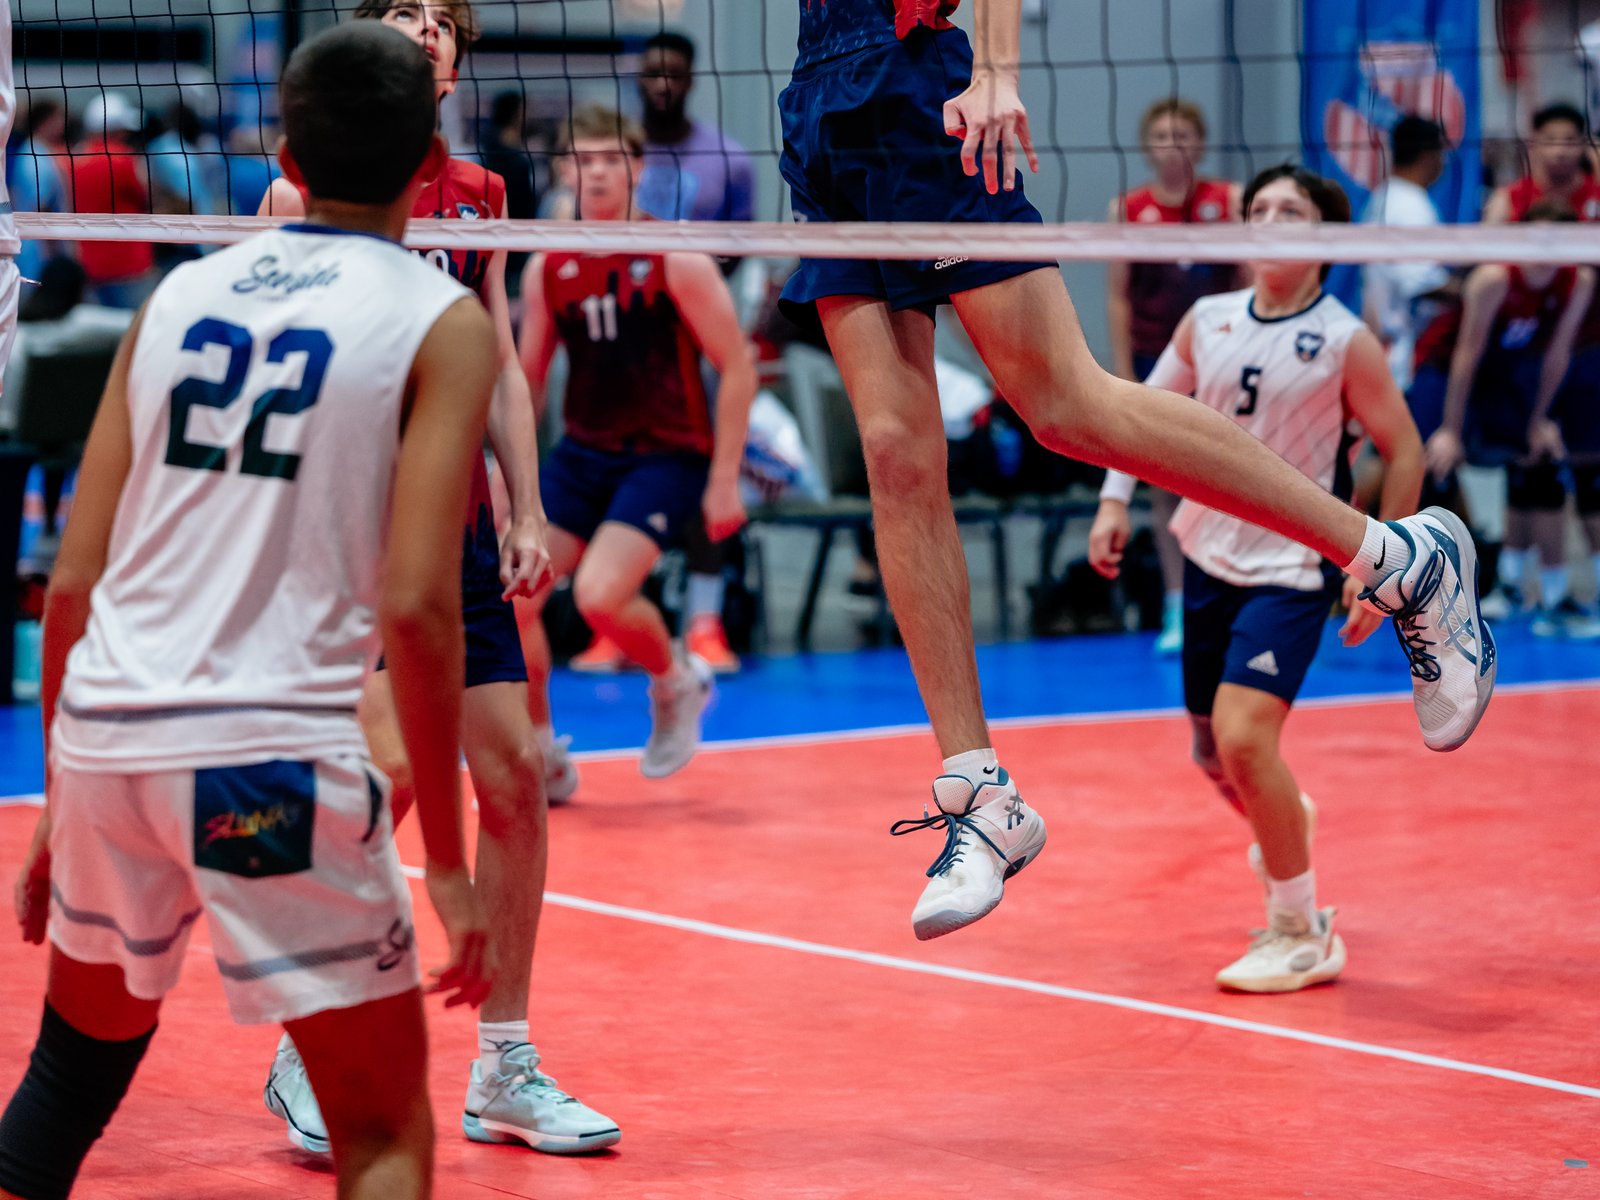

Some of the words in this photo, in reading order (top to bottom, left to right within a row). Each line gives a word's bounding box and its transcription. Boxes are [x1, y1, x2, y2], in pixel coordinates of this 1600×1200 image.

[580, 294, 617, 341] 11
[164, 316, 335, 481] 22
[1236, 366, 1262, 416] 5
